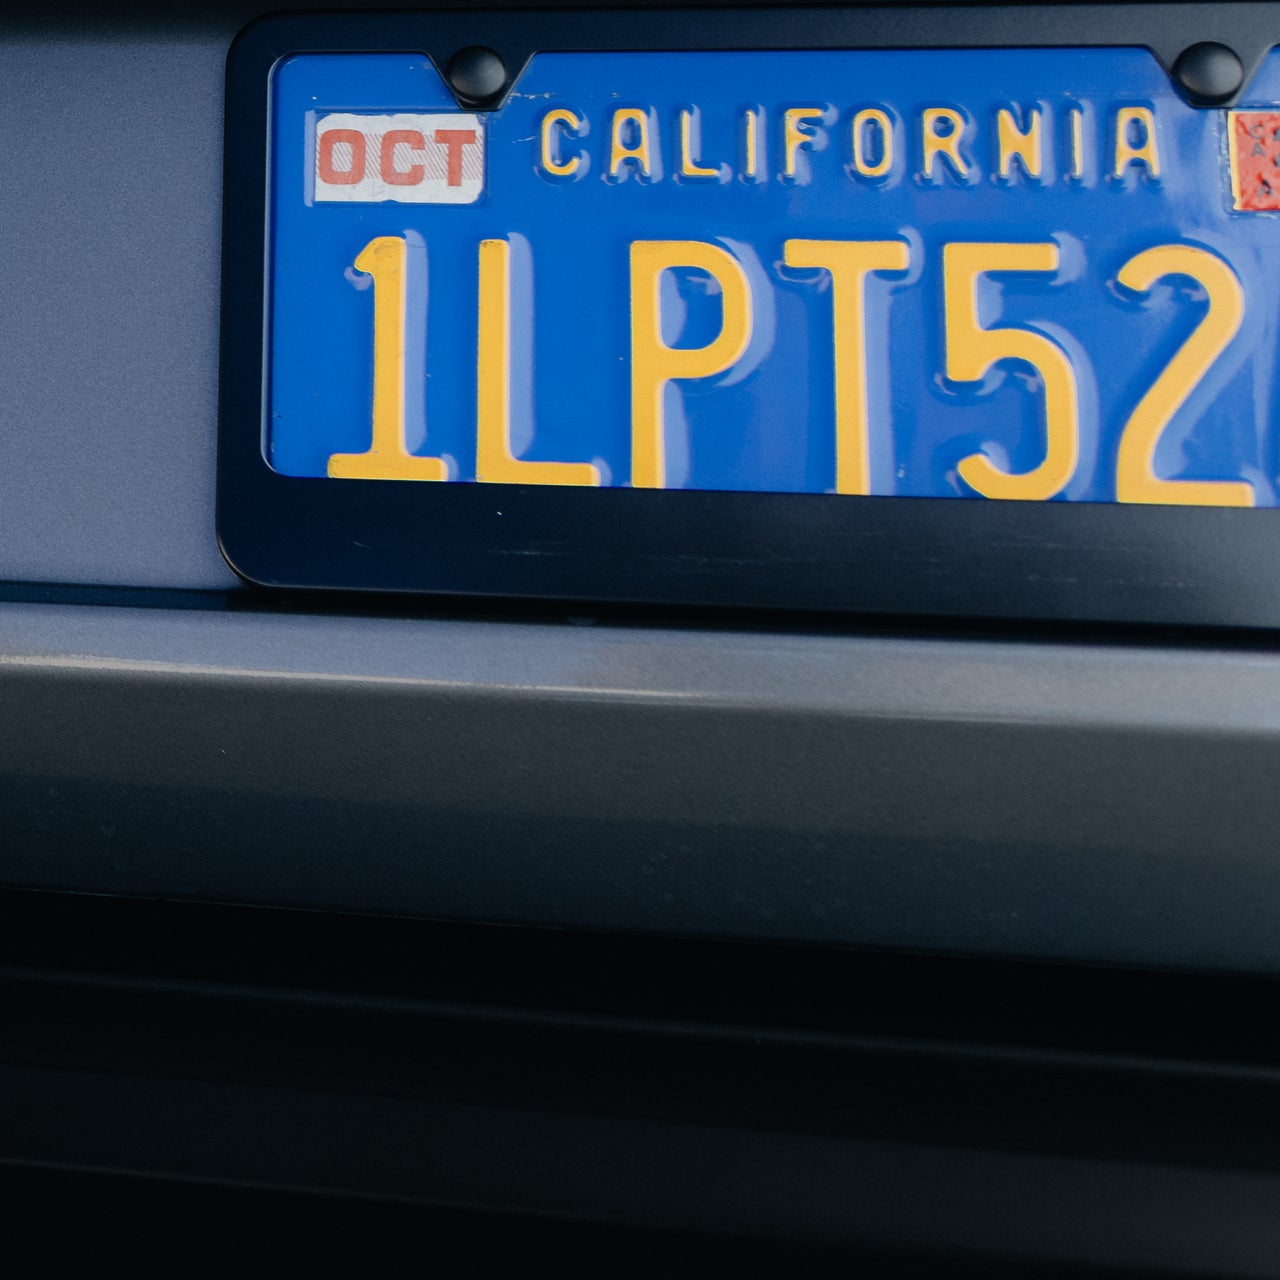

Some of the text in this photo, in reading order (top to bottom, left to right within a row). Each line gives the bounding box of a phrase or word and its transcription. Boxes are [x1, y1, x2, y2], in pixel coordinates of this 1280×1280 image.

[318, 128, 477, 187] OCT
[541, 107, 1160, 177] CALIFORNIA
[327, 236, 1255, 508] 1LPT52
